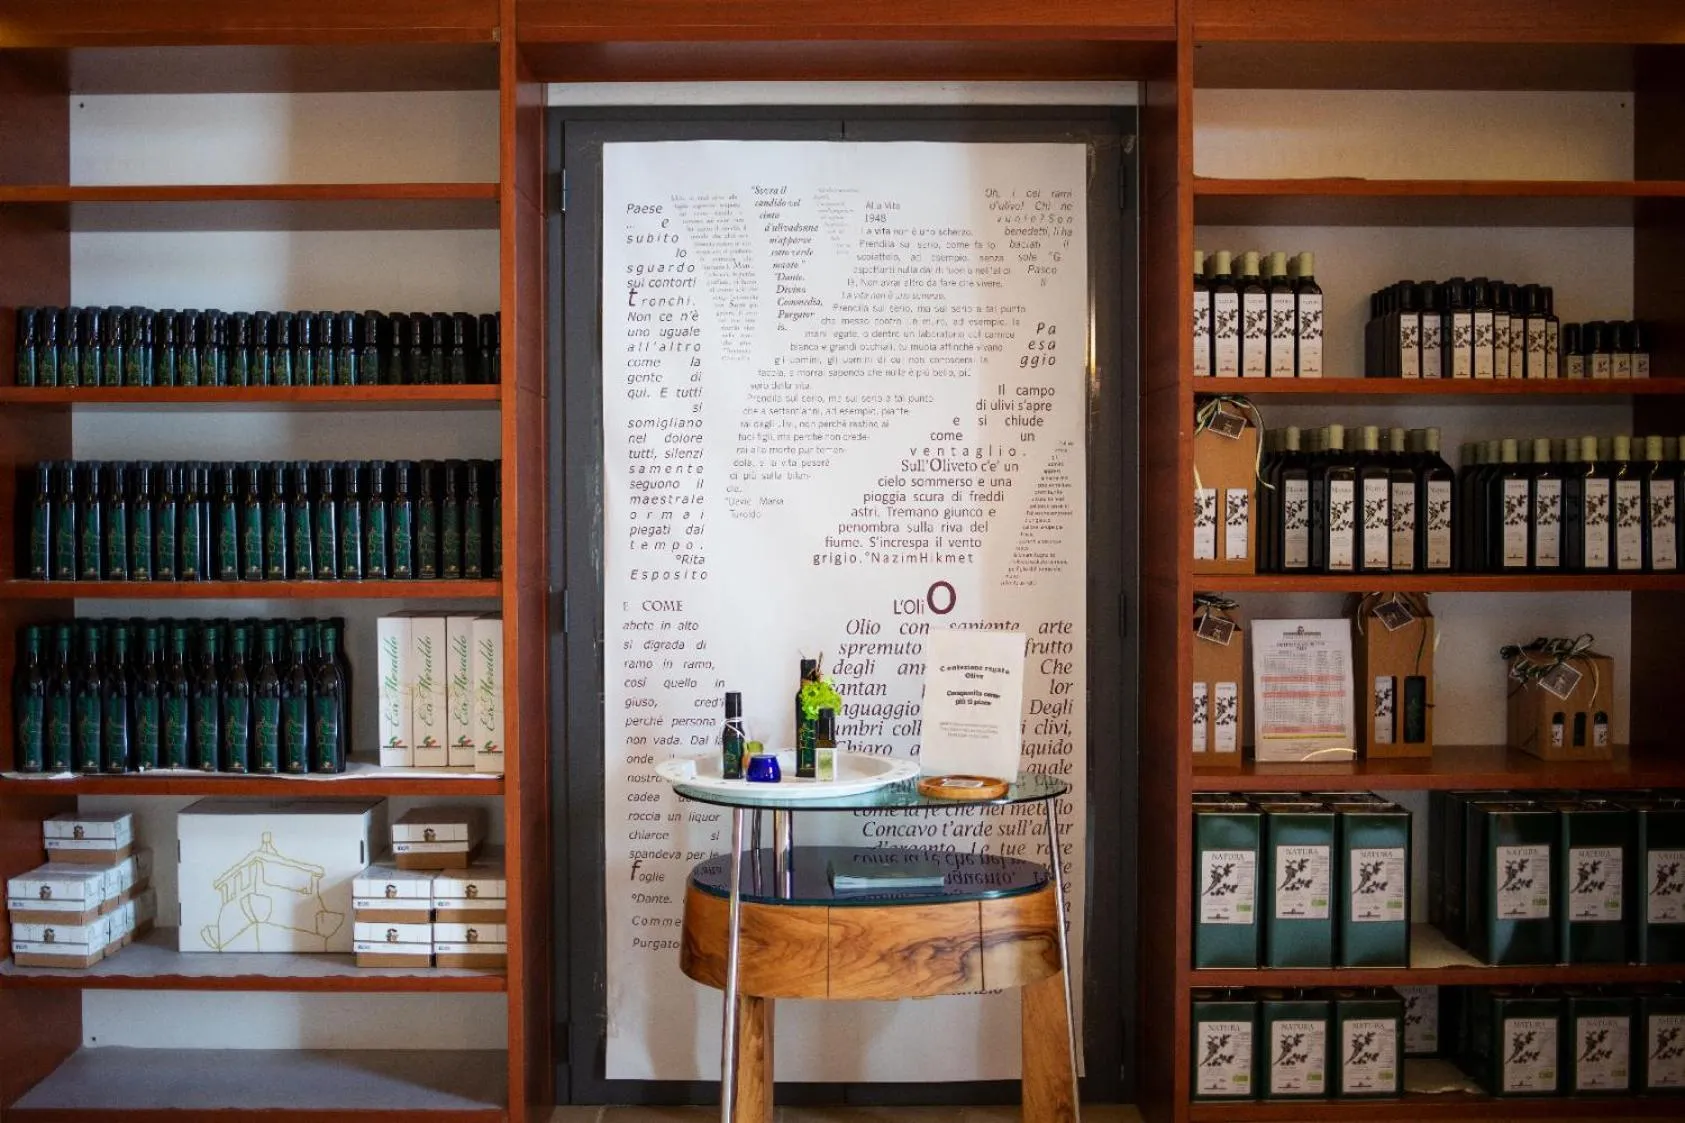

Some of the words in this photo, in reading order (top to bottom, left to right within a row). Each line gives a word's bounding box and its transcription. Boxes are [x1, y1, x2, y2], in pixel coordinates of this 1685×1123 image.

[627, 204, 663, 214] Paese
[661, 219, 669, 228] e
[865, 214, 886, 222] 1948
[627, 234, 679, 244] subito
[675, 248, 687, 258] lo
[627, 264, 695, 275] sguardo
[649, 278, 696, 288] contorti
[627, 312, 651, 322] Non
[659, 313, 672, 322] ce
[680, 311, 699, 322] n'è
[627, 328, 650, 337] uno
[659, 328, 700, 339] uguale
[627, 342, 701, 352] all'altro
[627, 358, 661, 367] come
[690, 357, 701, 367] la
[627, 374, 663, 384] gente
[690, 372, 701, 382] di
[660, 388, 668, 398] E
[676, 388, 703, 398] tutti
[998, 384, 1005, 395] Il
[1016, 386, 1055, 399] campo
[693, 403, 703, 413] si
[976, 400, 987, 411] di
[991, 400, 1014, 411] ulivi
[1018, 400, 1052, 413] s'apre
[628, 418, 703, 430] somigliano
[953, 416, 960, 426] e
[979, 415, 987, 426] si
[1005, 414, 1044, 427] chiude
[628, 434, 646, 443] nel
[665, 434, 703, 443] dolore
[930, 431, 963, 441] come
[1021, 432, 1035, 441] un
[628, 449, 657, 460] tutti,
[665, 449, 703, 459] silenzi
[910, 444, 1027, 458] ventaglio.
[629, 465, 704, 474] samente
[901, 458, 977, 472] Sull'Oliveto
[1004, 462, 1019, 471] un
[630, 480, 680, 491] seguono
[696, 479, 704, 489] il
[878, 475, 906, 487] cielo
[911, 476, 973, 487] sommerso
[978, 477, 985, 487] e
[990, 477, 1012, 487] una
[630, 495, 704, 504] maestrale
[863, 491, 906, 505] pioggia
[913, 492, 944, 501] scura
[951, 490, 962, 501] di
[969, 490, 1004, 501] freddi
[851, 506, 880, 517] astri.
[887, 506, 938, 517] Tremano
[944, 506, 983, 520] giunco
[988, 507, 996, 517] e
[630, 525, 671, 537] piegati
[838, 521, 900, 534] penombra
[907, 521, 933, 532] sulla
[941, 521, 962, 532] riva
[970, 521, 988, 532] del
[630, 540, 704, 552] tempo.
[825, 537, 863, 548] fiume.
[869, 537, 929, 550] S'increspa
[935, 536, 942, 548] il
[948, 537, 982, 548] vento
[630, 569, 708, 581] Esposito
[642, 600, 684, 611] COME
[660, 621, 671, 630] in
[678, 621, 699, 631] alto
[846, 619, 881, 635] Olio
[900, 622, 930, 635] con
[1039, 620, 1073, 634] arte
[624, 640, 633, 650] si
[644, 640, 685, 652] digrada
[696, 640, 707, 650] di
[839, 640, 922, 658] spremuto
[1025, 637, 1073, 659] frutto
[624, 661, 653, 669] ramo
[663, 659, 673, 669] in
[683, 661, 715, 670] ramo,
[833, 660, 875, 679] degli
[1041, 659, 1073, 675] Che
[624, 678, 647, 688] così
[664, 679, 697, 690] quello
[715, 679, 725, 688] in
[1050, 680, 1073, 695] lor
[625, 698, 658, 709] giuso,
[1030, 699, 1073, 719] Degli
[625, 716, 663, 727] perché
[672, 718, 716, 727] persona
[1035, 721, 1072, 737] clivi,
[626, 736, 647, 745] non
[653, 736, 683, 745] vada.
[690, 735, 709, 745] Dal
[627, 754, 654, 764] onde
[628, 792, 660, 802] cadea
[628, 812, 661, 821] roccia
[668, 813, 682, 821] un
[688, 812, 720, 823] liquor
[863, 822, 937, 837] Concavo
[943, 821, 993, 836] t'arde
[997, 820, 1073, 836] sull'alar
[711, 831, 720, 840] si
[629, 849, 682, 860] spandeva
[686, 851, 705, 861] per
[632, 916, 681, 927] Comme
[632, 937, 680, 950] Purgato
